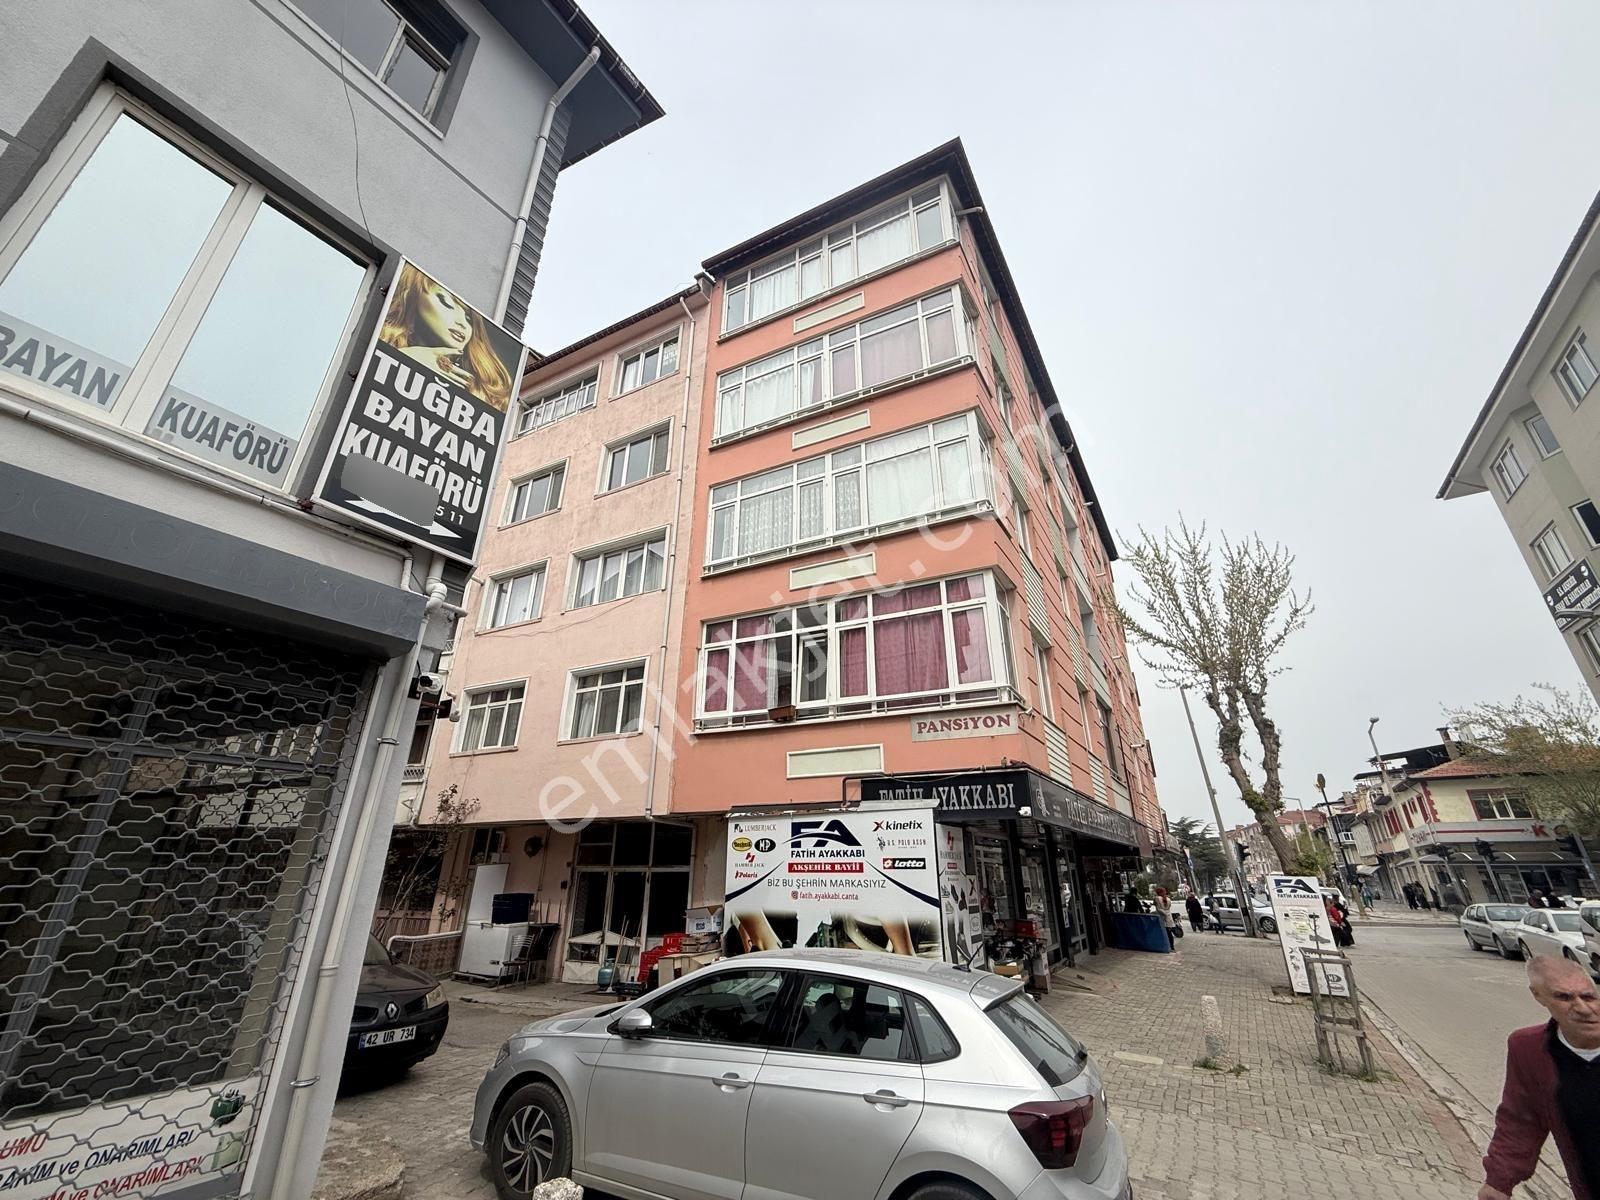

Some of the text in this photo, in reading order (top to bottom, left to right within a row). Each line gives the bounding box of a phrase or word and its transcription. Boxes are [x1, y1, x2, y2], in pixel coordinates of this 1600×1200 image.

[373, 349, 495, 446] TUĞBA
[157, 397, 288, 474] KUAFÖRÜ
[363, 389, 486, 475] BAYAN
[931, 783, 1016, 811] AYAKKABI
[885, 820, 922, 830] kinetix
[790, 849, 865, 858] FATİH AYAKKABI
[791, 862, 832, 872] AKŞEHİR
[767, 878, 886, 889] BİZ BU ŞEHRİN MARKASIYIZ
[366, 1027, 415, 1045] 42 UR 734
[59, 1160, 80, 1176] ve
[85, 1130, 195, 1169] ONARIMLARI
